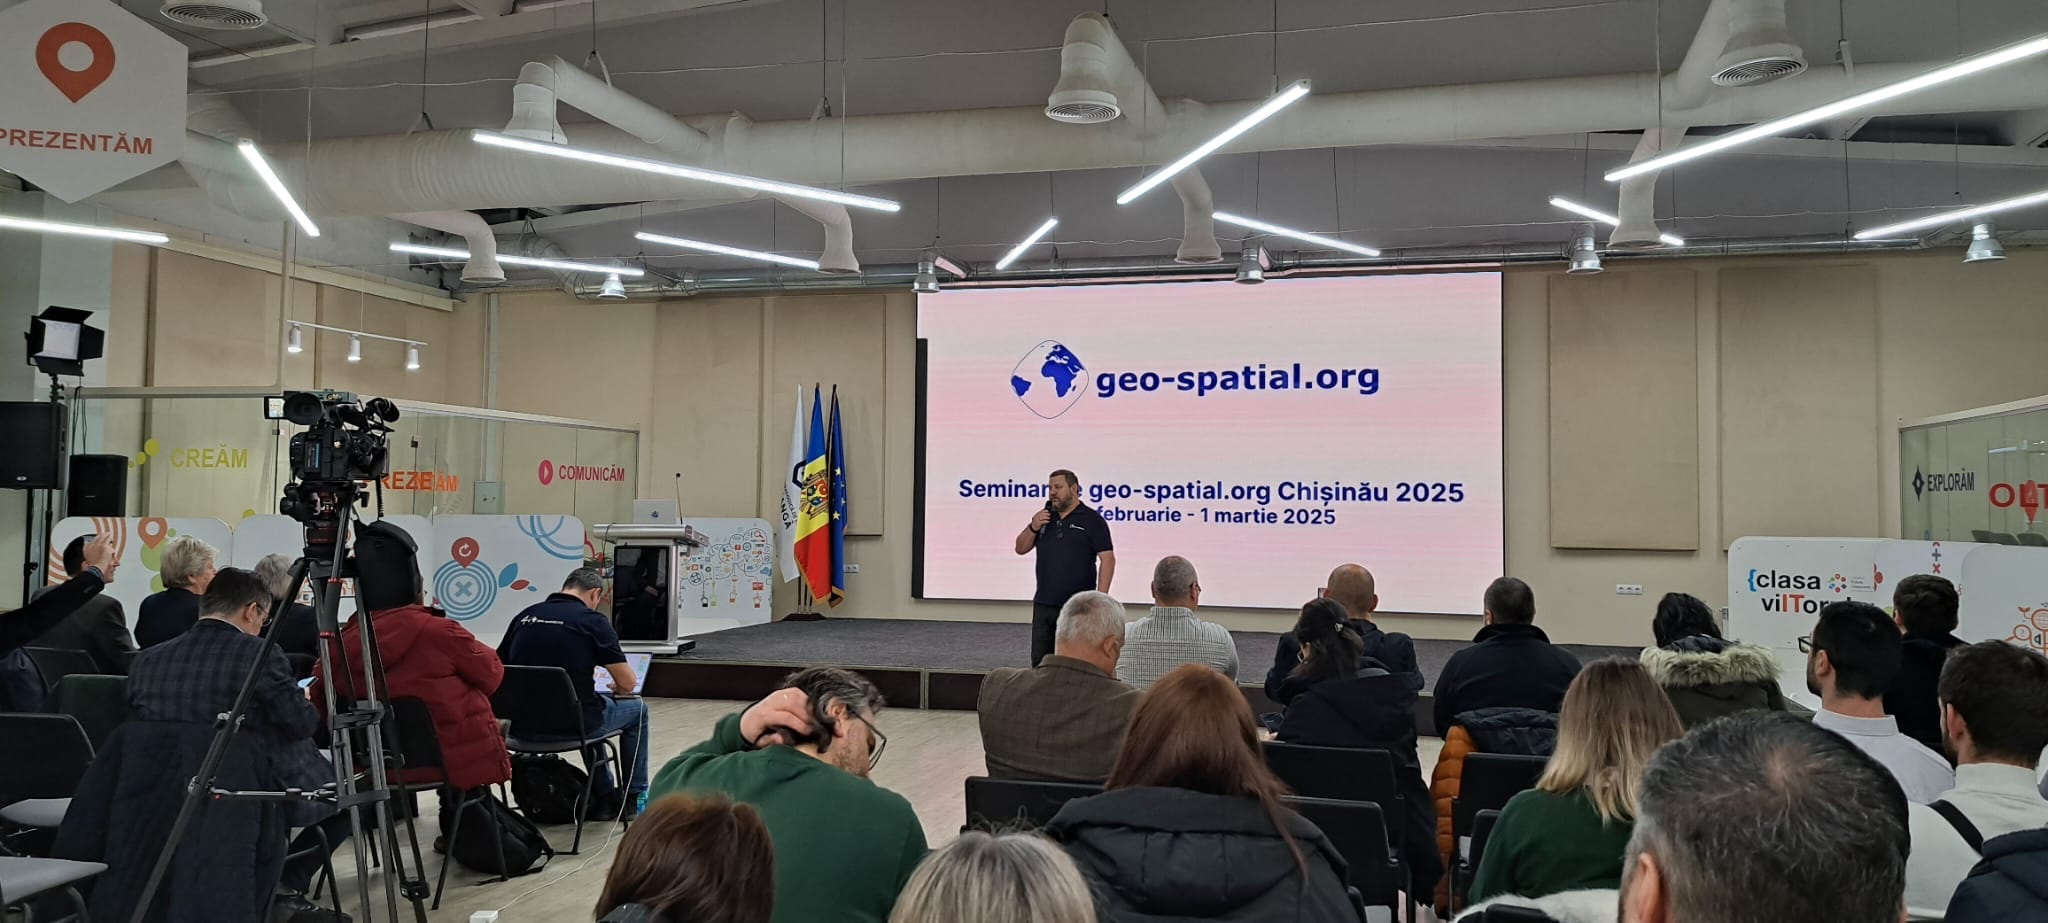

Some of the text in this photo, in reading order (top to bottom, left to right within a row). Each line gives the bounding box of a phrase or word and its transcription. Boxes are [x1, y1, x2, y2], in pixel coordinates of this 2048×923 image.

[1096, 362, 1380, 398] geo-spatial.org
[171, 443, 249, 468] CREĂM
[558, 464, 625, 482] COMUNICĂM
[1927, 467, 1975, 492] EXPLORĂM
[1089, 480, 1271, 505] geo-spatial.org
[1278, 481, 1389, 506] Chișinău
[1395, 482, 1465, 502] 2025
[1098, 505, 1182, 522] februarie
[1200, 508, 1209, 523] 1
[1214, 508, 1278, 524] martie
[1283, 508, 1336, 525] 2025
